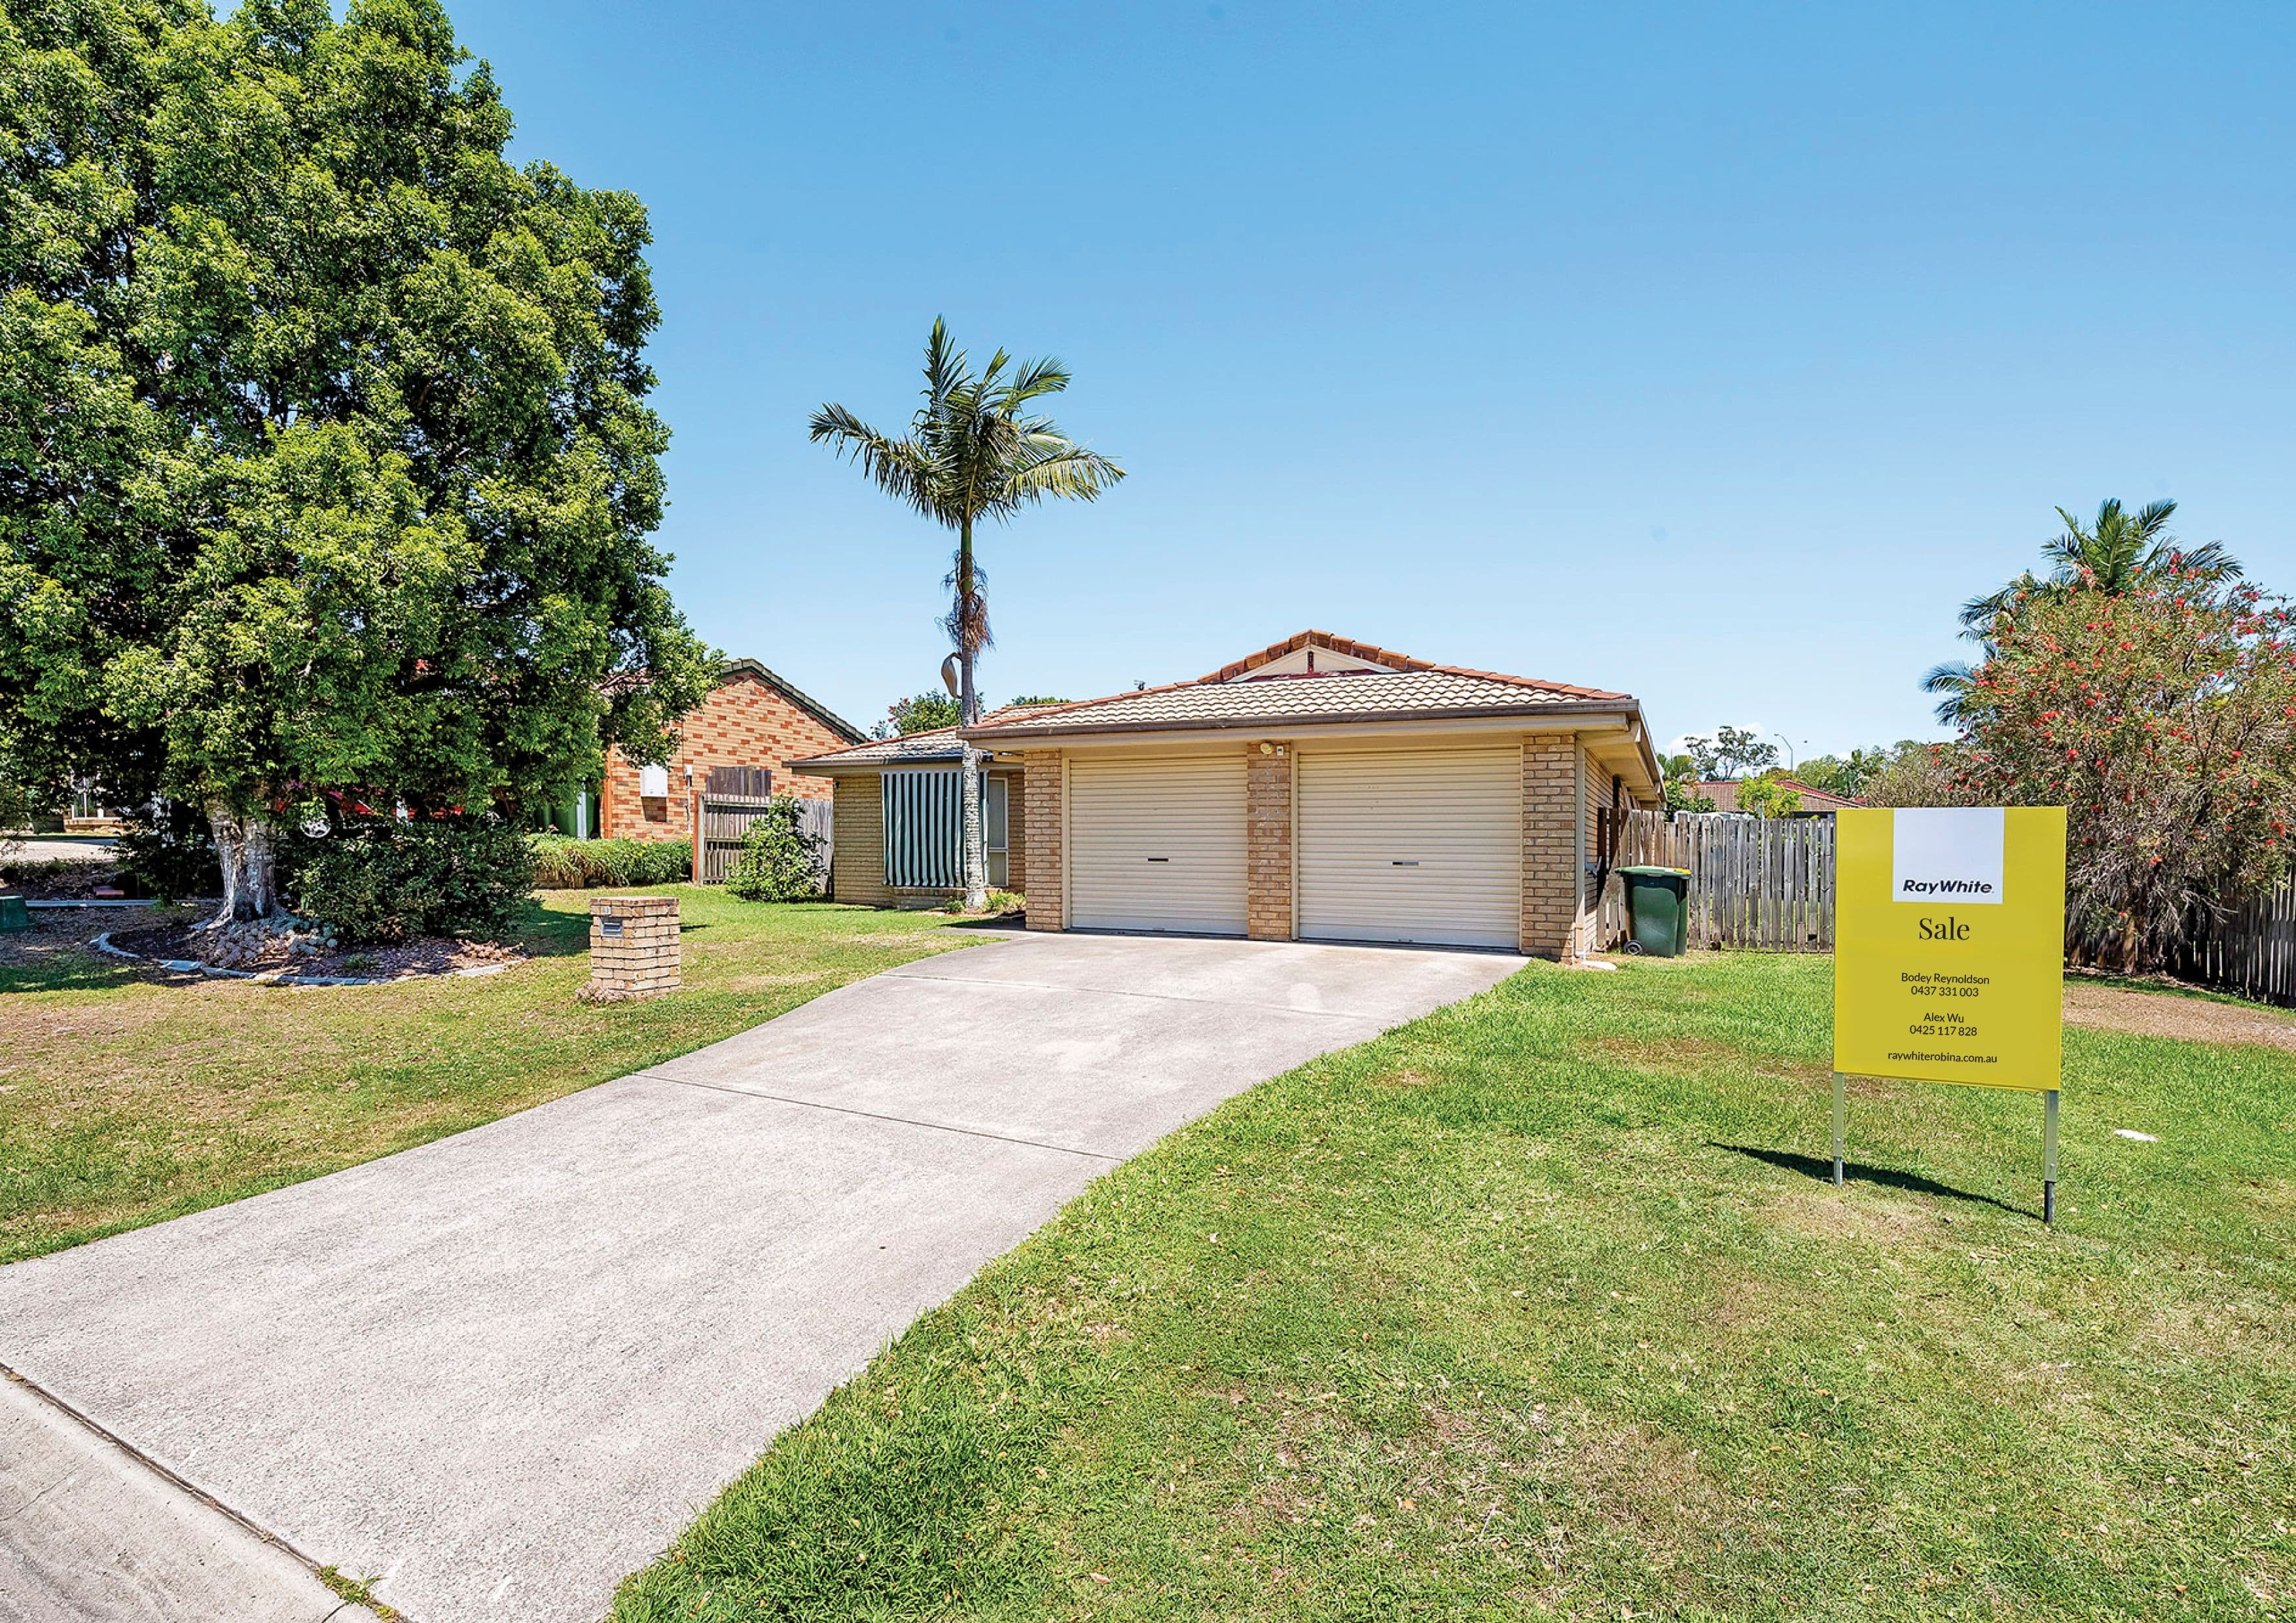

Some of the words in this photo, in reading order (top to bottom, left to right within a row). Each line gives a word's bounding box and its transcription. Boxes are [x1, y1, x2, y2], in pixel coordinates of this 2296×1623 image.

[1918, 916, 1970, 940] Sale
[1901, 972, 1932, 984] Bodey
[1933, 972, 1990, 985] Reynoldson
[1910, 985, 1937, 995] 0437
[1938, 986, 1958, 997] 331
[1959, 987, 1979, 997] 003
[1923, 1012, 1946, 1022] Alex
[1946, 1012, 1964, 1024] Wu
[1909, 1024, 1935, 1035] 0425
[1937, 1026, 1957, 1035] 117
[1958, 1026, 1978, 1037] 828
[1888, 1050, 1998, 1063] raywhiterobina.com.au
